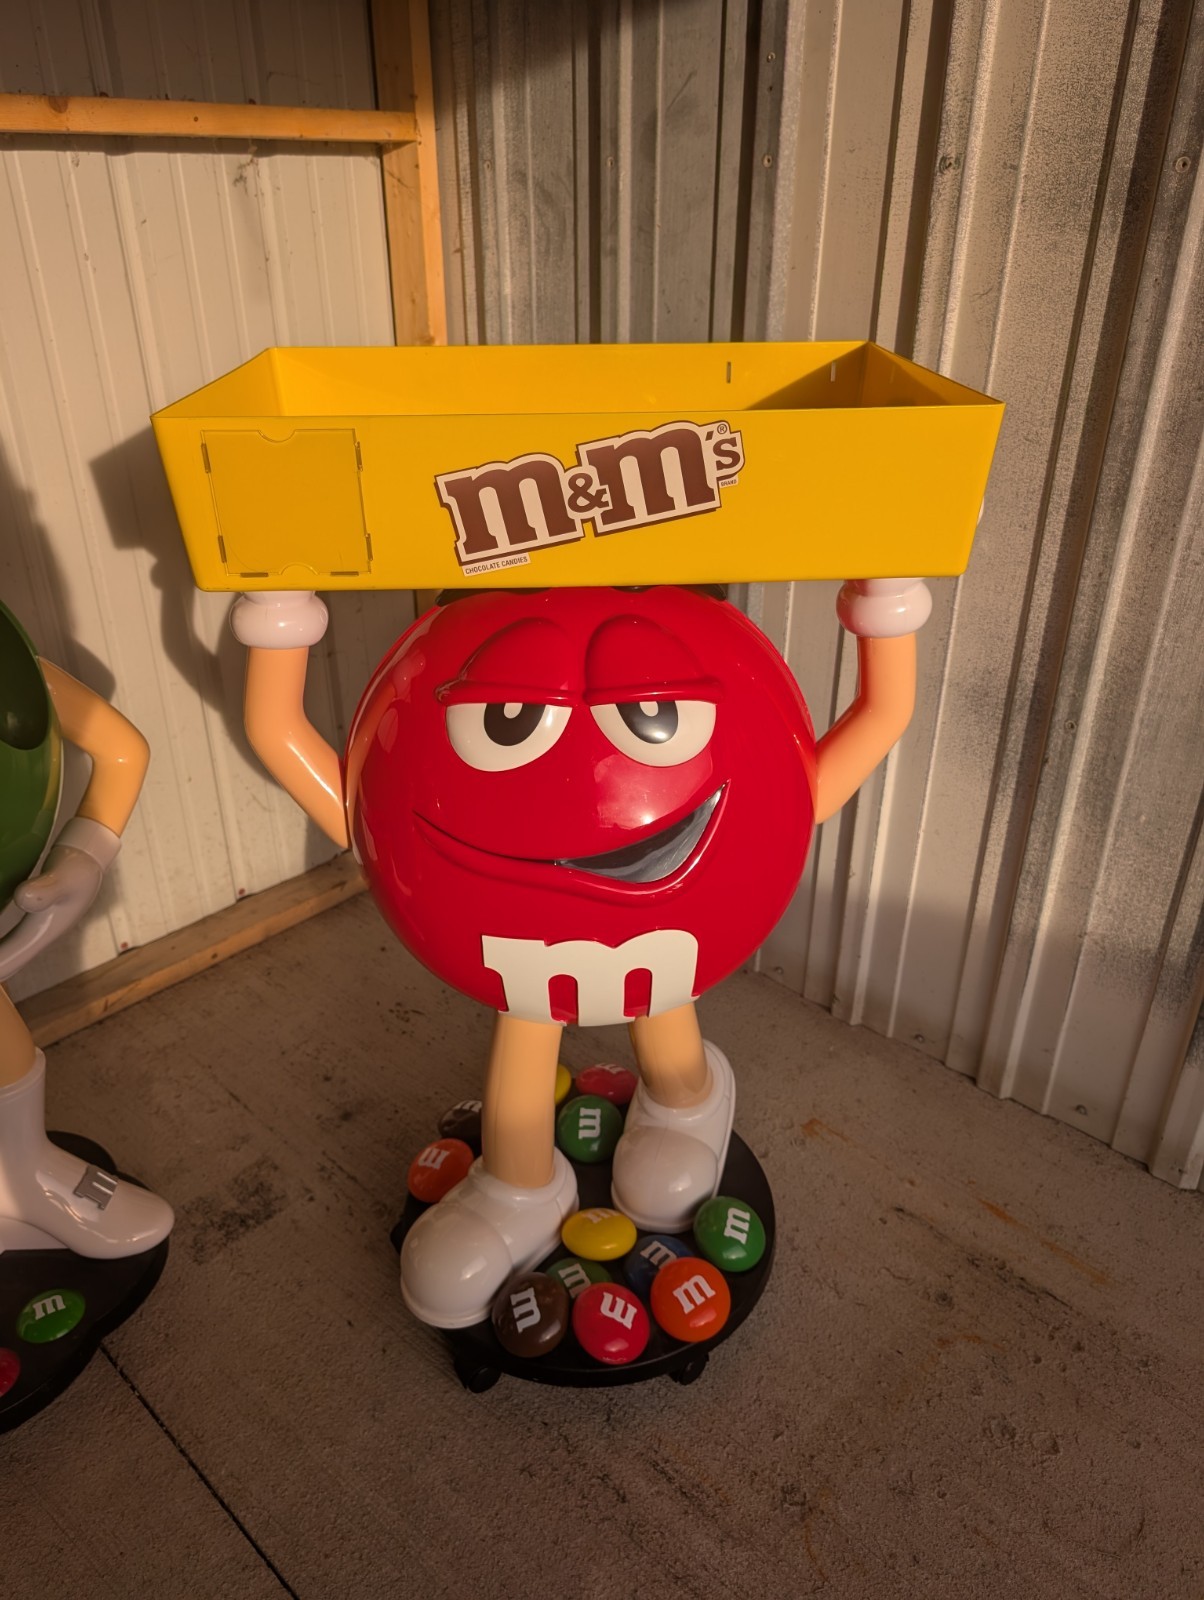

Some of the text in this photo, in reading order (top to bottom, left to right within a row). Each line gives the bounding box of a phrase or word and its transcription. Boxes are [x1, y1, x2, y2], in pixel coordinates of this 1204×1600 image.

[464, 556, 528, 575] CHOCOLATE CANDIES
[481, 929, 700, 1027] m
[578, 1106, 602, 1140] m
[723, 1207, 751, 1245] m
[32, 1294, 66, 1321] m
[509, 1286, 542, 1334] m
[672, 1274, 716, 1314] m
